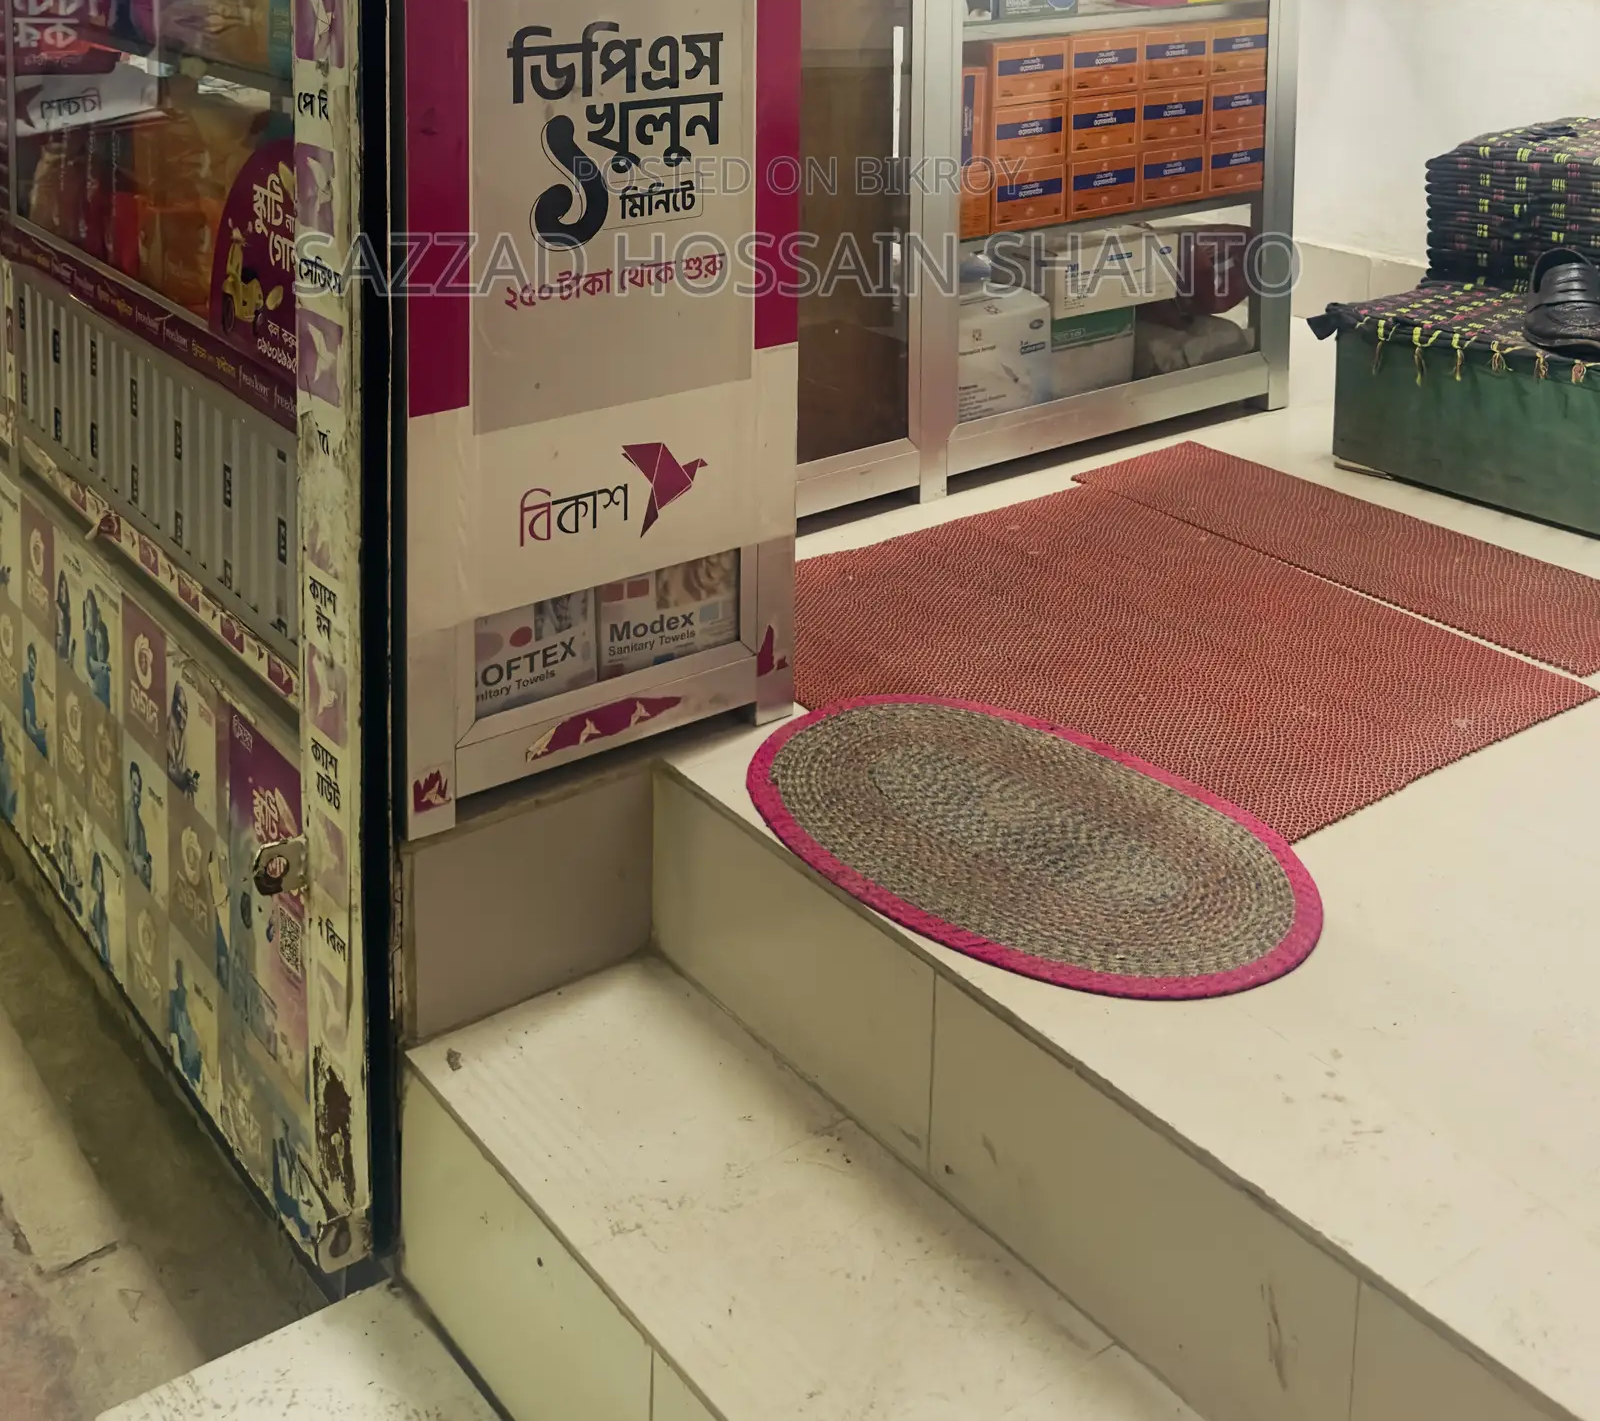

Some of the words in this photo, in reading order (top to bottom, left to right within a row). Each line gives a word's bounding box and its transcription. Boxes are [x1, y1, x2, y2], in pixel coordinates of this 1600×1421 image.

[507, 20, 724, 105] ডিপিএস
[585, 92, 724, 174] খুলুন
[529, 114, 609, 252] ১
[619, 180, 696, 220] মিনিটে
[619, 261, 678, 292] থেকে
[683, 252, 726, 279] শুরু
[519, 483, 629, 548] বিকাশ
[308, 575, 338, 615] ক্যাশ
[608, 638, 656, 658] Sanitary
[659, 628, 696, 647] Towels
[609, 611, 695, 644] Modex
[516, 669, 556, 691] Towels
[310, 735, 339, 775] ক্যাশ
